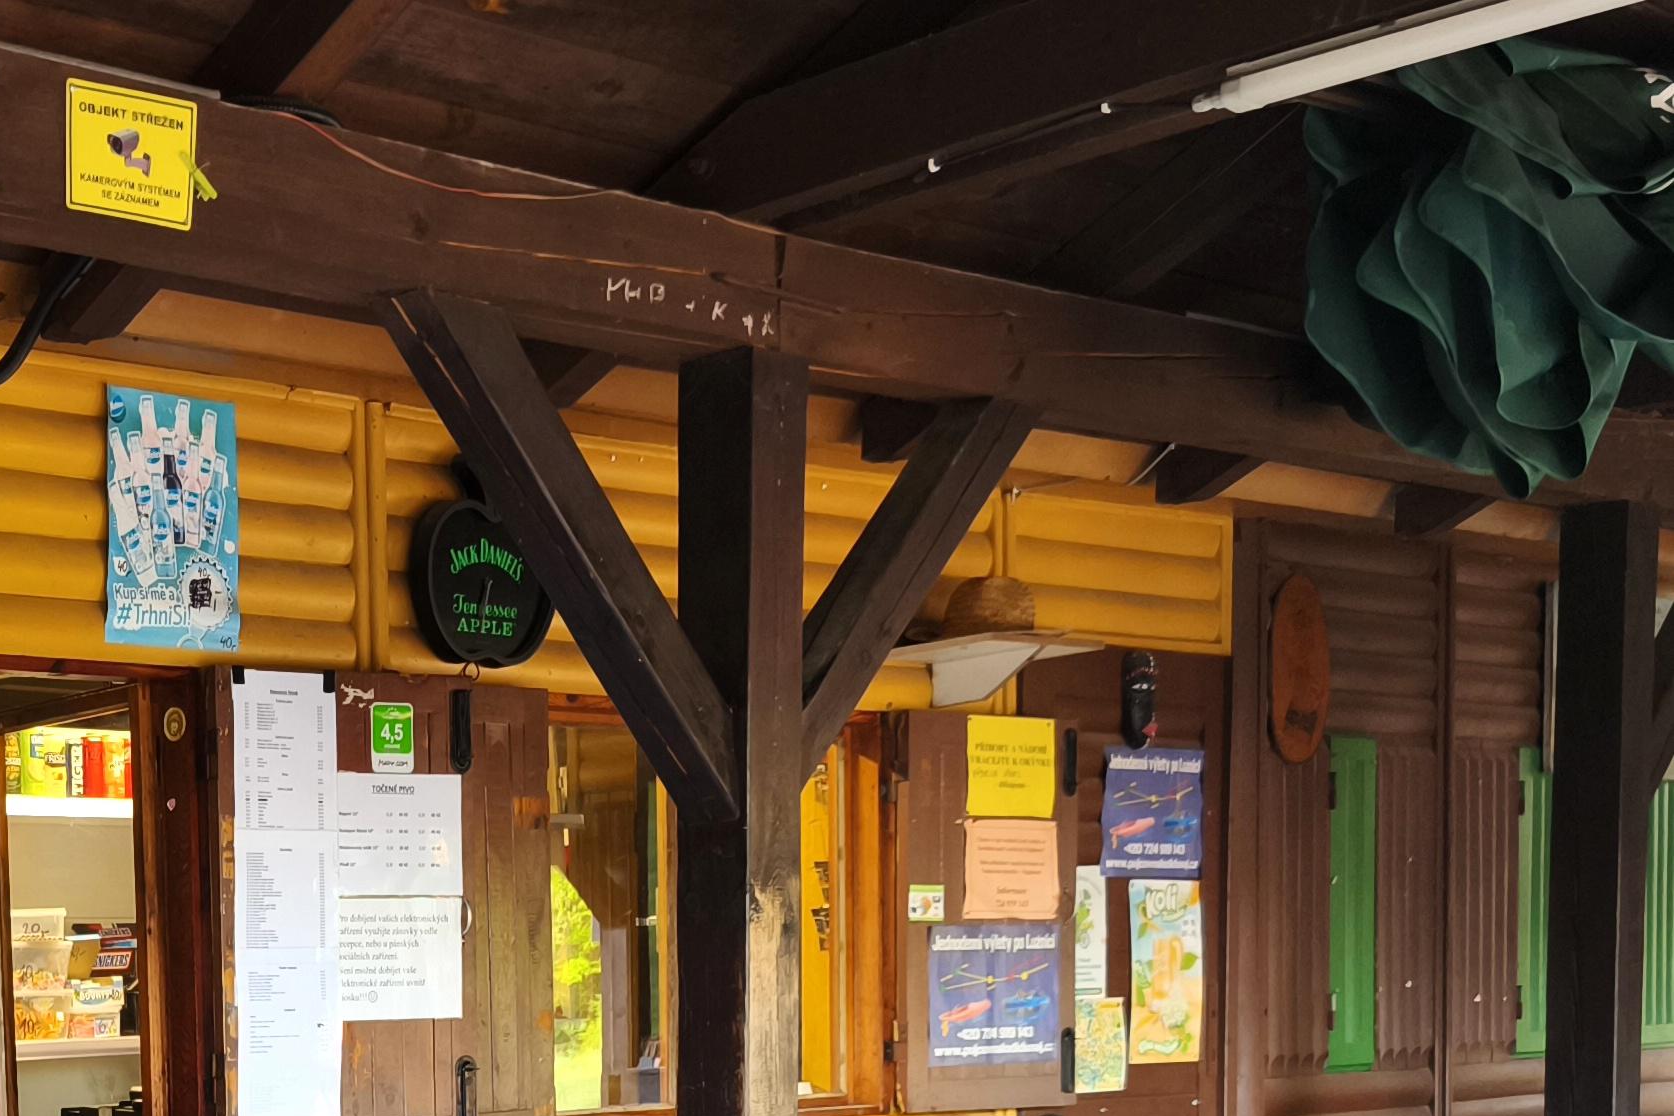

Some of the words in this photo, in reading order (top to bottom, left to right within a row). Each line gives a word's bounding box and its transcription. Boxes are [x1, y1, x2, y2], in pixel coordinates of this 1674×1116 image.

[79, 101, 127, 118] OBJEKT
[131, 109, 184, 131] STŘEŽEN
[79, 172, 135, 191] KAMEROVÝM
[137, 182, 181, 199] SYSTÉMEM
[101, 189, 113, 200] SE
[114, 190, 160, 208] ZÁZNAMEM
[450, 544, 479, 575] JACK
[114, 585, 137, 602] Kup
[139, 588, 149, 600] si
[151, 585, 167, 601] mě
[168, 591, 175, 601] a
[117, 603, 191, 626] #TrhniSi!
[457, 617, 514, 637] APPLE
[380, 722, 404, 745] 4,5
[371, 783, 398, 794] TOČENÉ
[398, 785, 415, 795] PIVO
[95, 954, 130, 968] NICKERS
